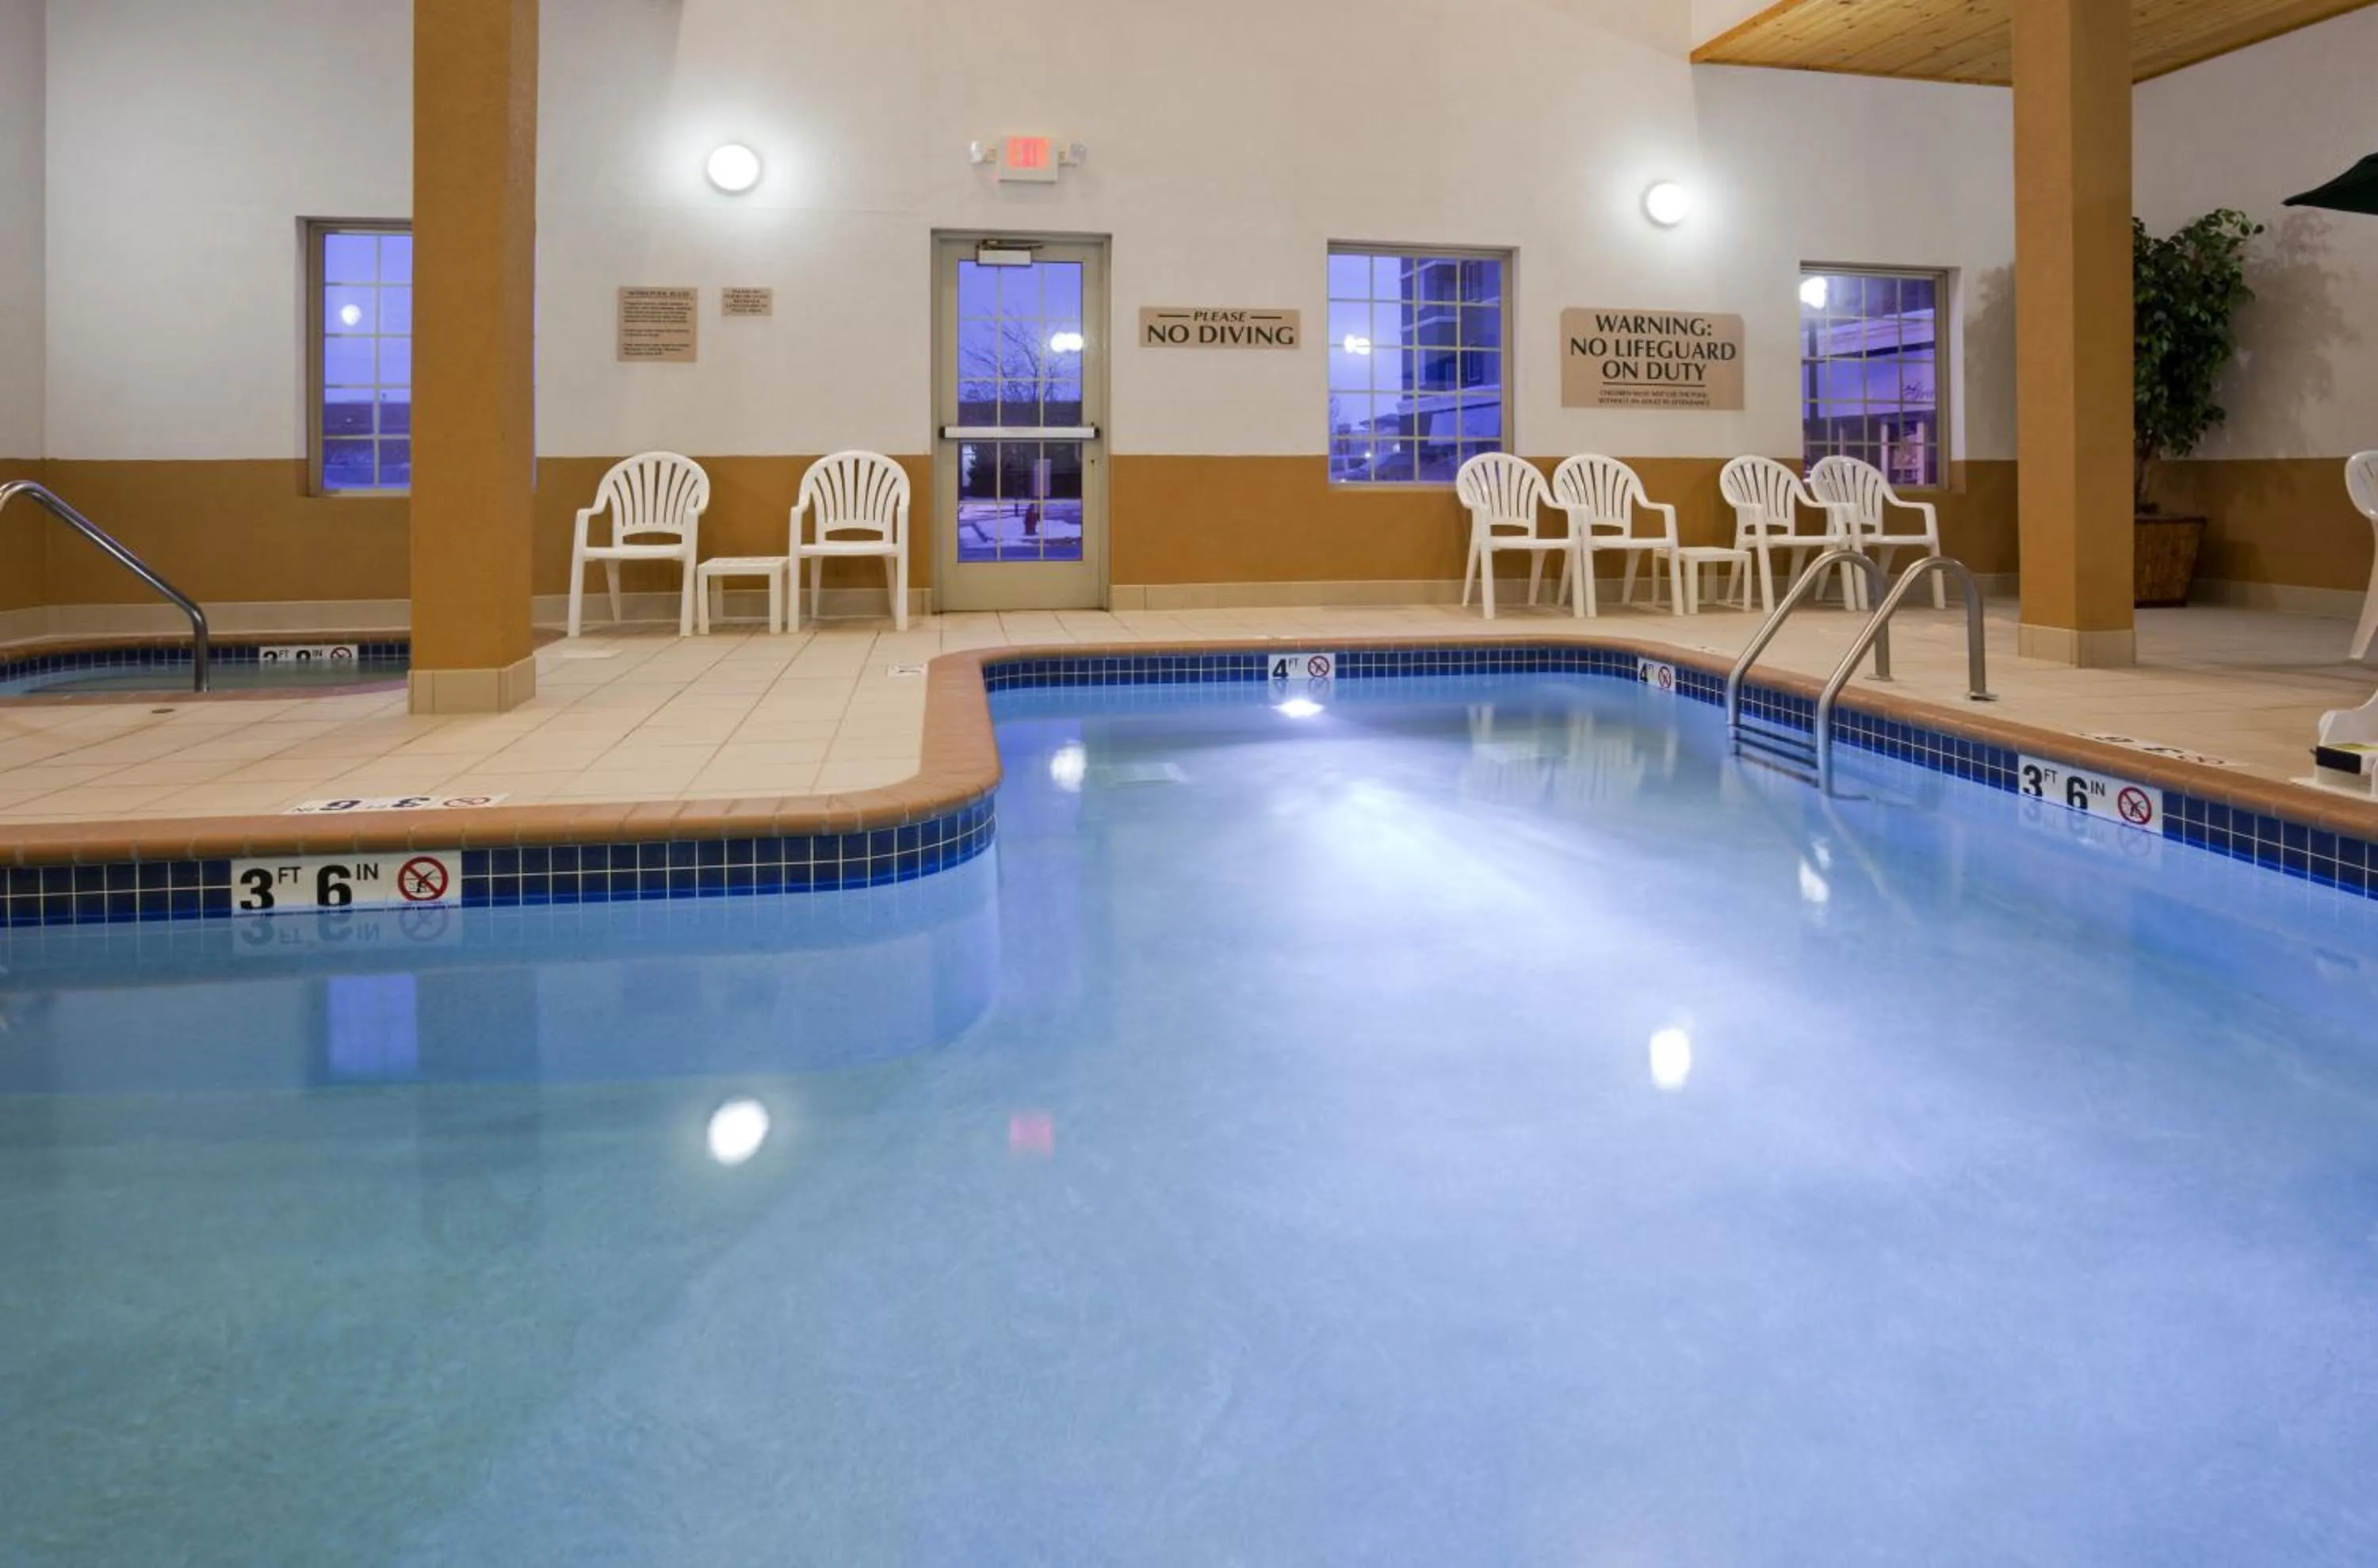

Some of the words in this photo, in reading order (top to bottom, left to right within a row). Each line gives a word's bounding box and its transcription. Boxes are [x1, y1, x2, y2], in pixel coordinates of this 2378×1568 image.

[1194, 310, 1247, 322] PLEASE
[1596, 314, 1712, 337] WARNING:
[1148, 324, 1189, 343] NO
[1199, 325, 1294, 345] DIVING
[1570, 337, 1608, 357] NO
[1615, 338, 1737, 361] LIFEGUARD
[1602, 360, 1638, 380] ON
[1646, 361, 1707, 381] DUTY
[1272, 659, 1289, 677] 4
[2023, 764, 2043, 797] 3
[2044, 770, 2058, 783] FT
[2066, 776, 2088, 810] 6
[2090, 780, 2105, 796] IN
[240, 868, 275, 910] 3
[278, 866, 302, 884] FT
[317, 865, 352, 906] 6
[357, 863, 379, 881] IN
